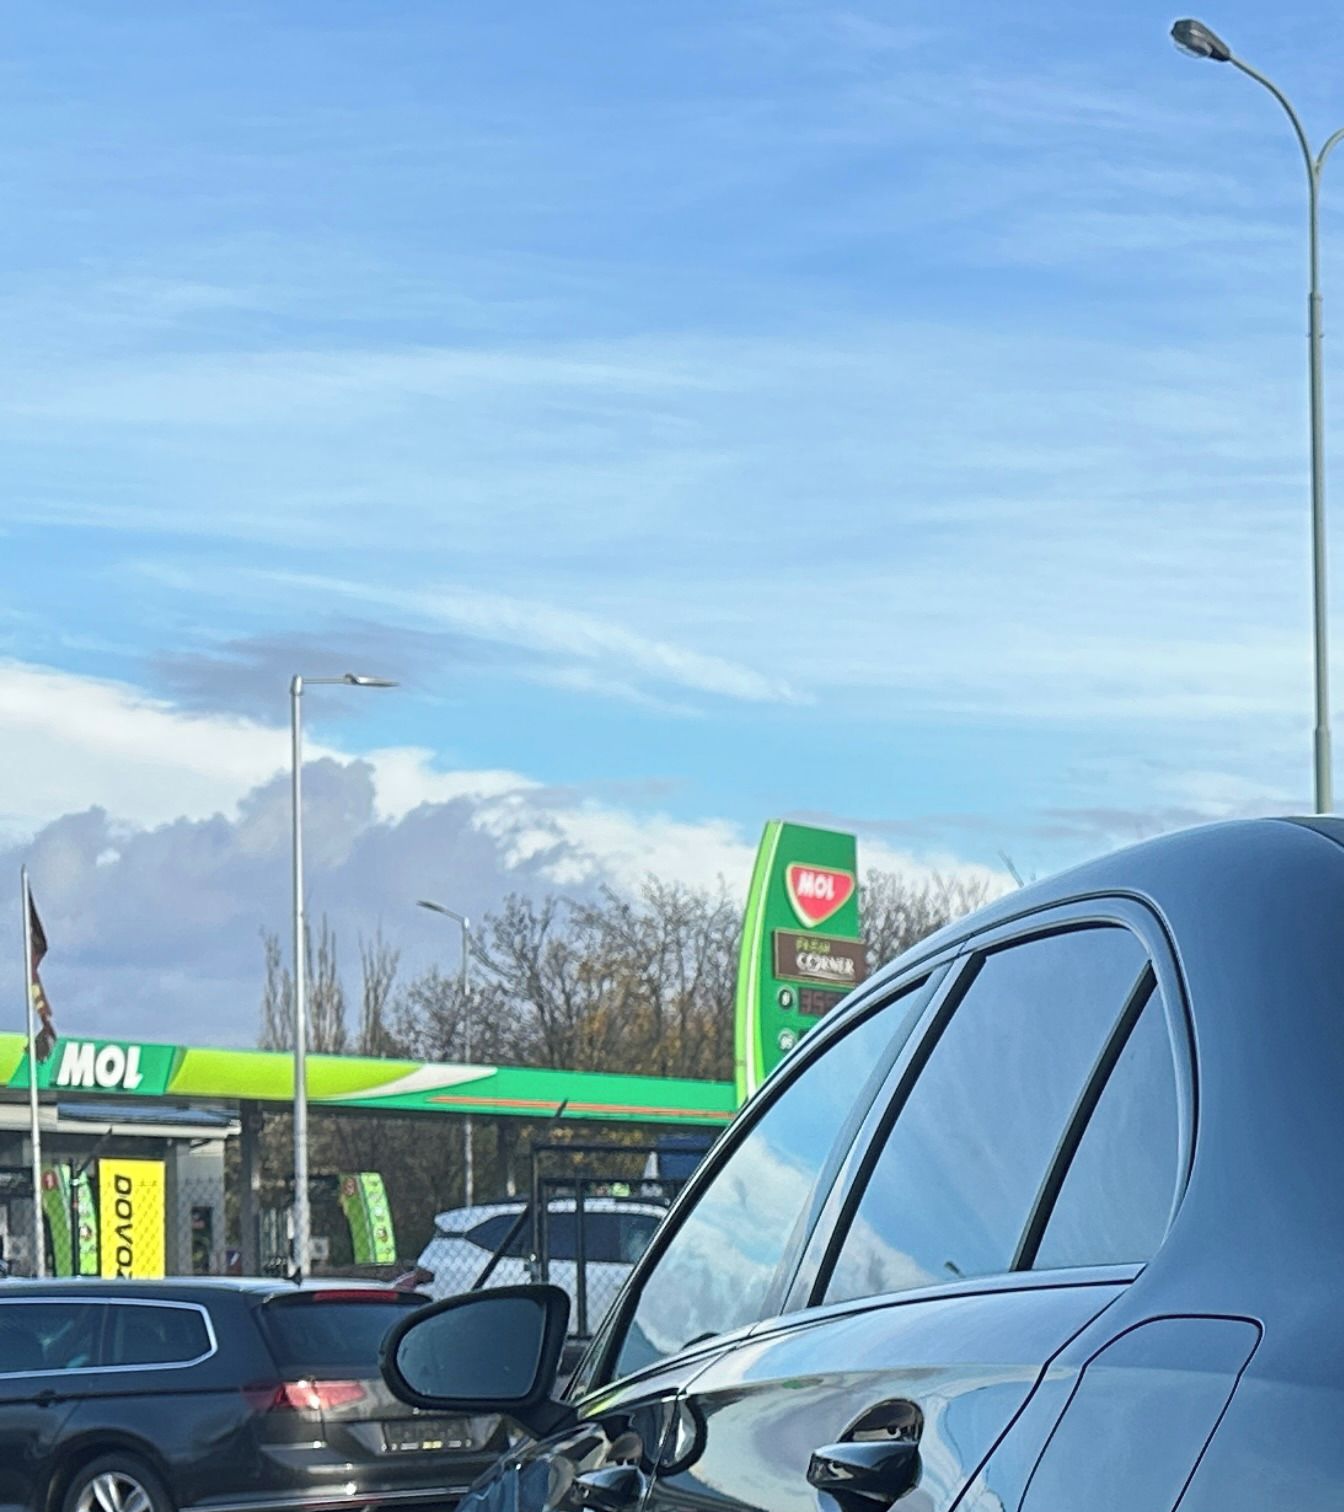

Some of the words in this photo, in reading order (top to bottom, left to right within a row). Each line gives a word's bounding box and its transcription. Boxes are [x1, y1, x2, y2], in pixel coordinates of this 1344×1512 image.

[797, 871, 836, 900] MOL
[796, 952, 855, 977] CORNER
[56, 1042, 143, 1090] MOL
